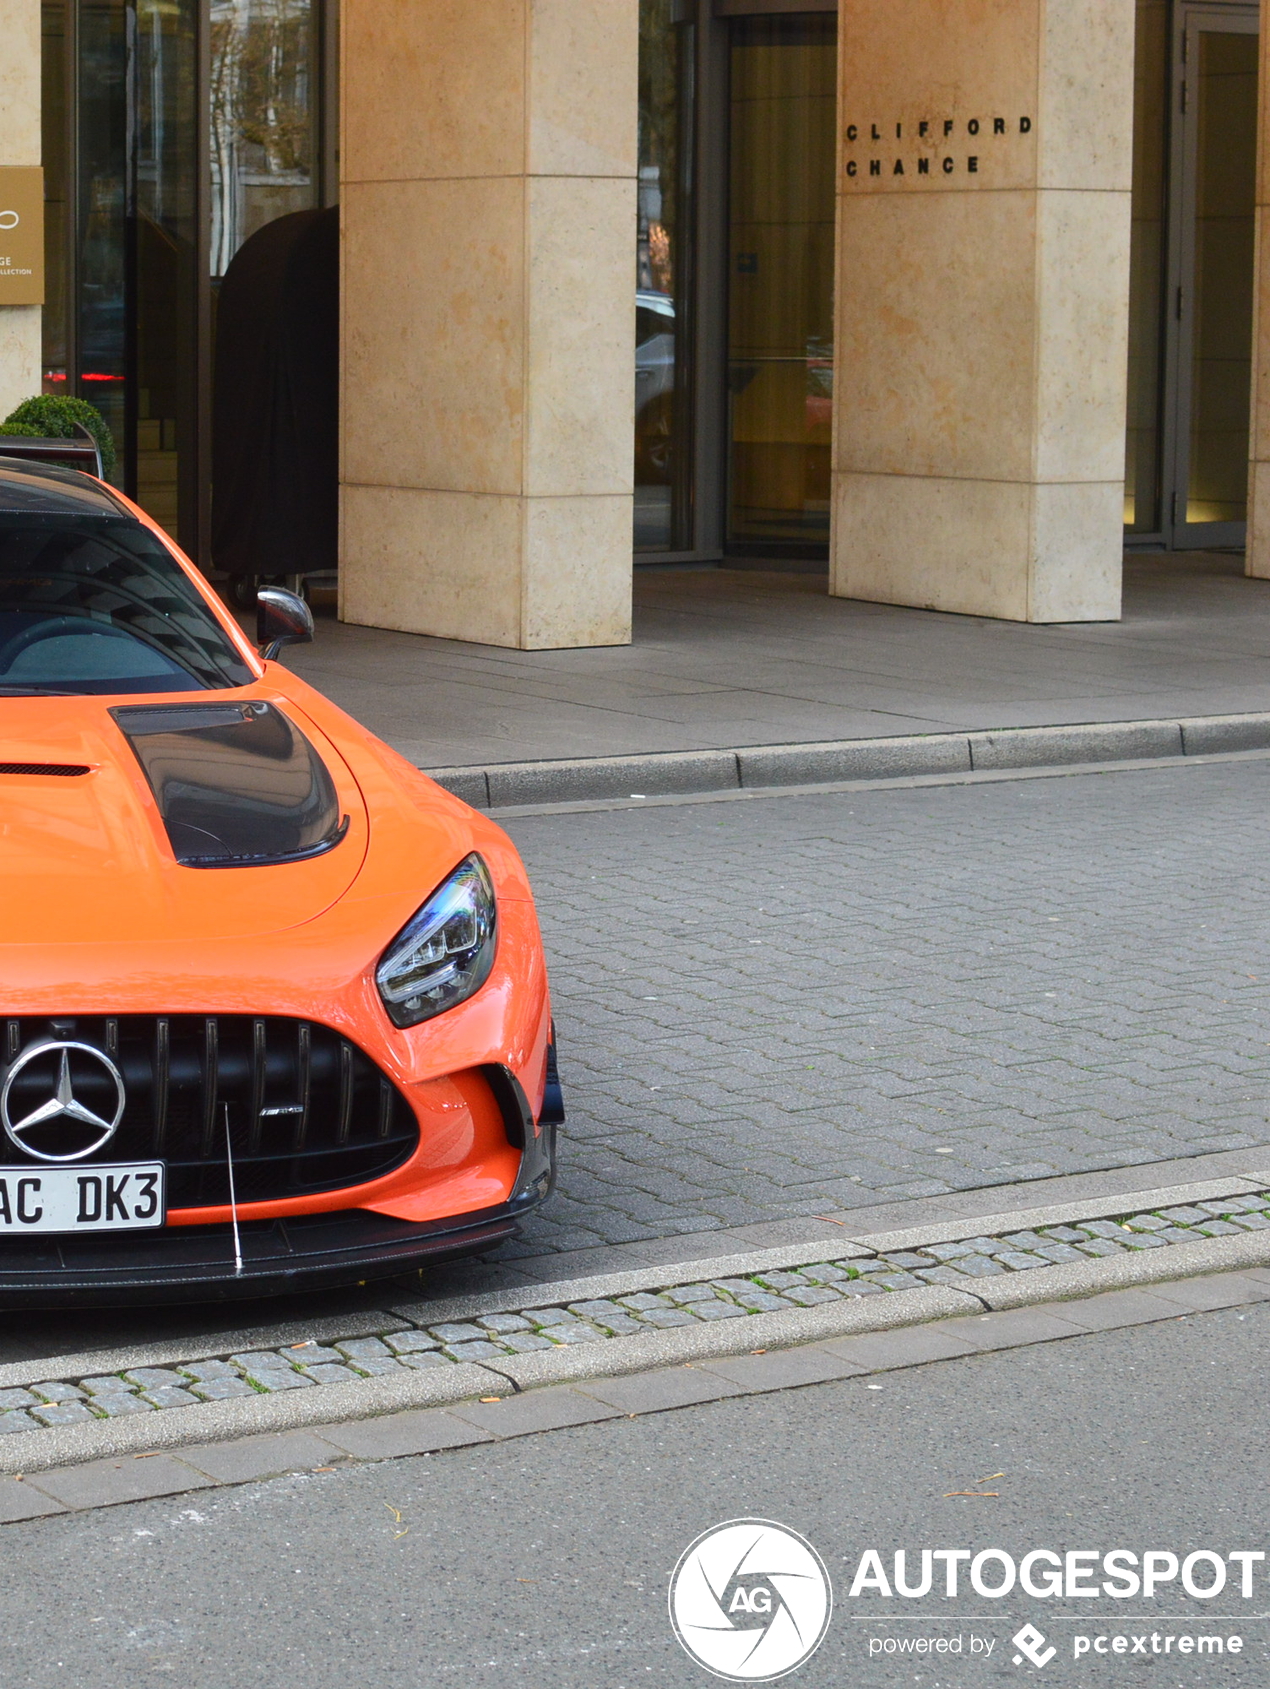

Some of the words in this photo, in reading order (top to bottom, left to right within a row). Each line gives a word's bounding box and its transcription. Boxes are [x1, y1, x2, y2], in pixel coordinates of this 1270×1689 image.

[847, 117, 1031, 141] CLIFFORD
[847, 156, 978, 177] CHANCE
[76, 1172, 158, 1223] DK3
